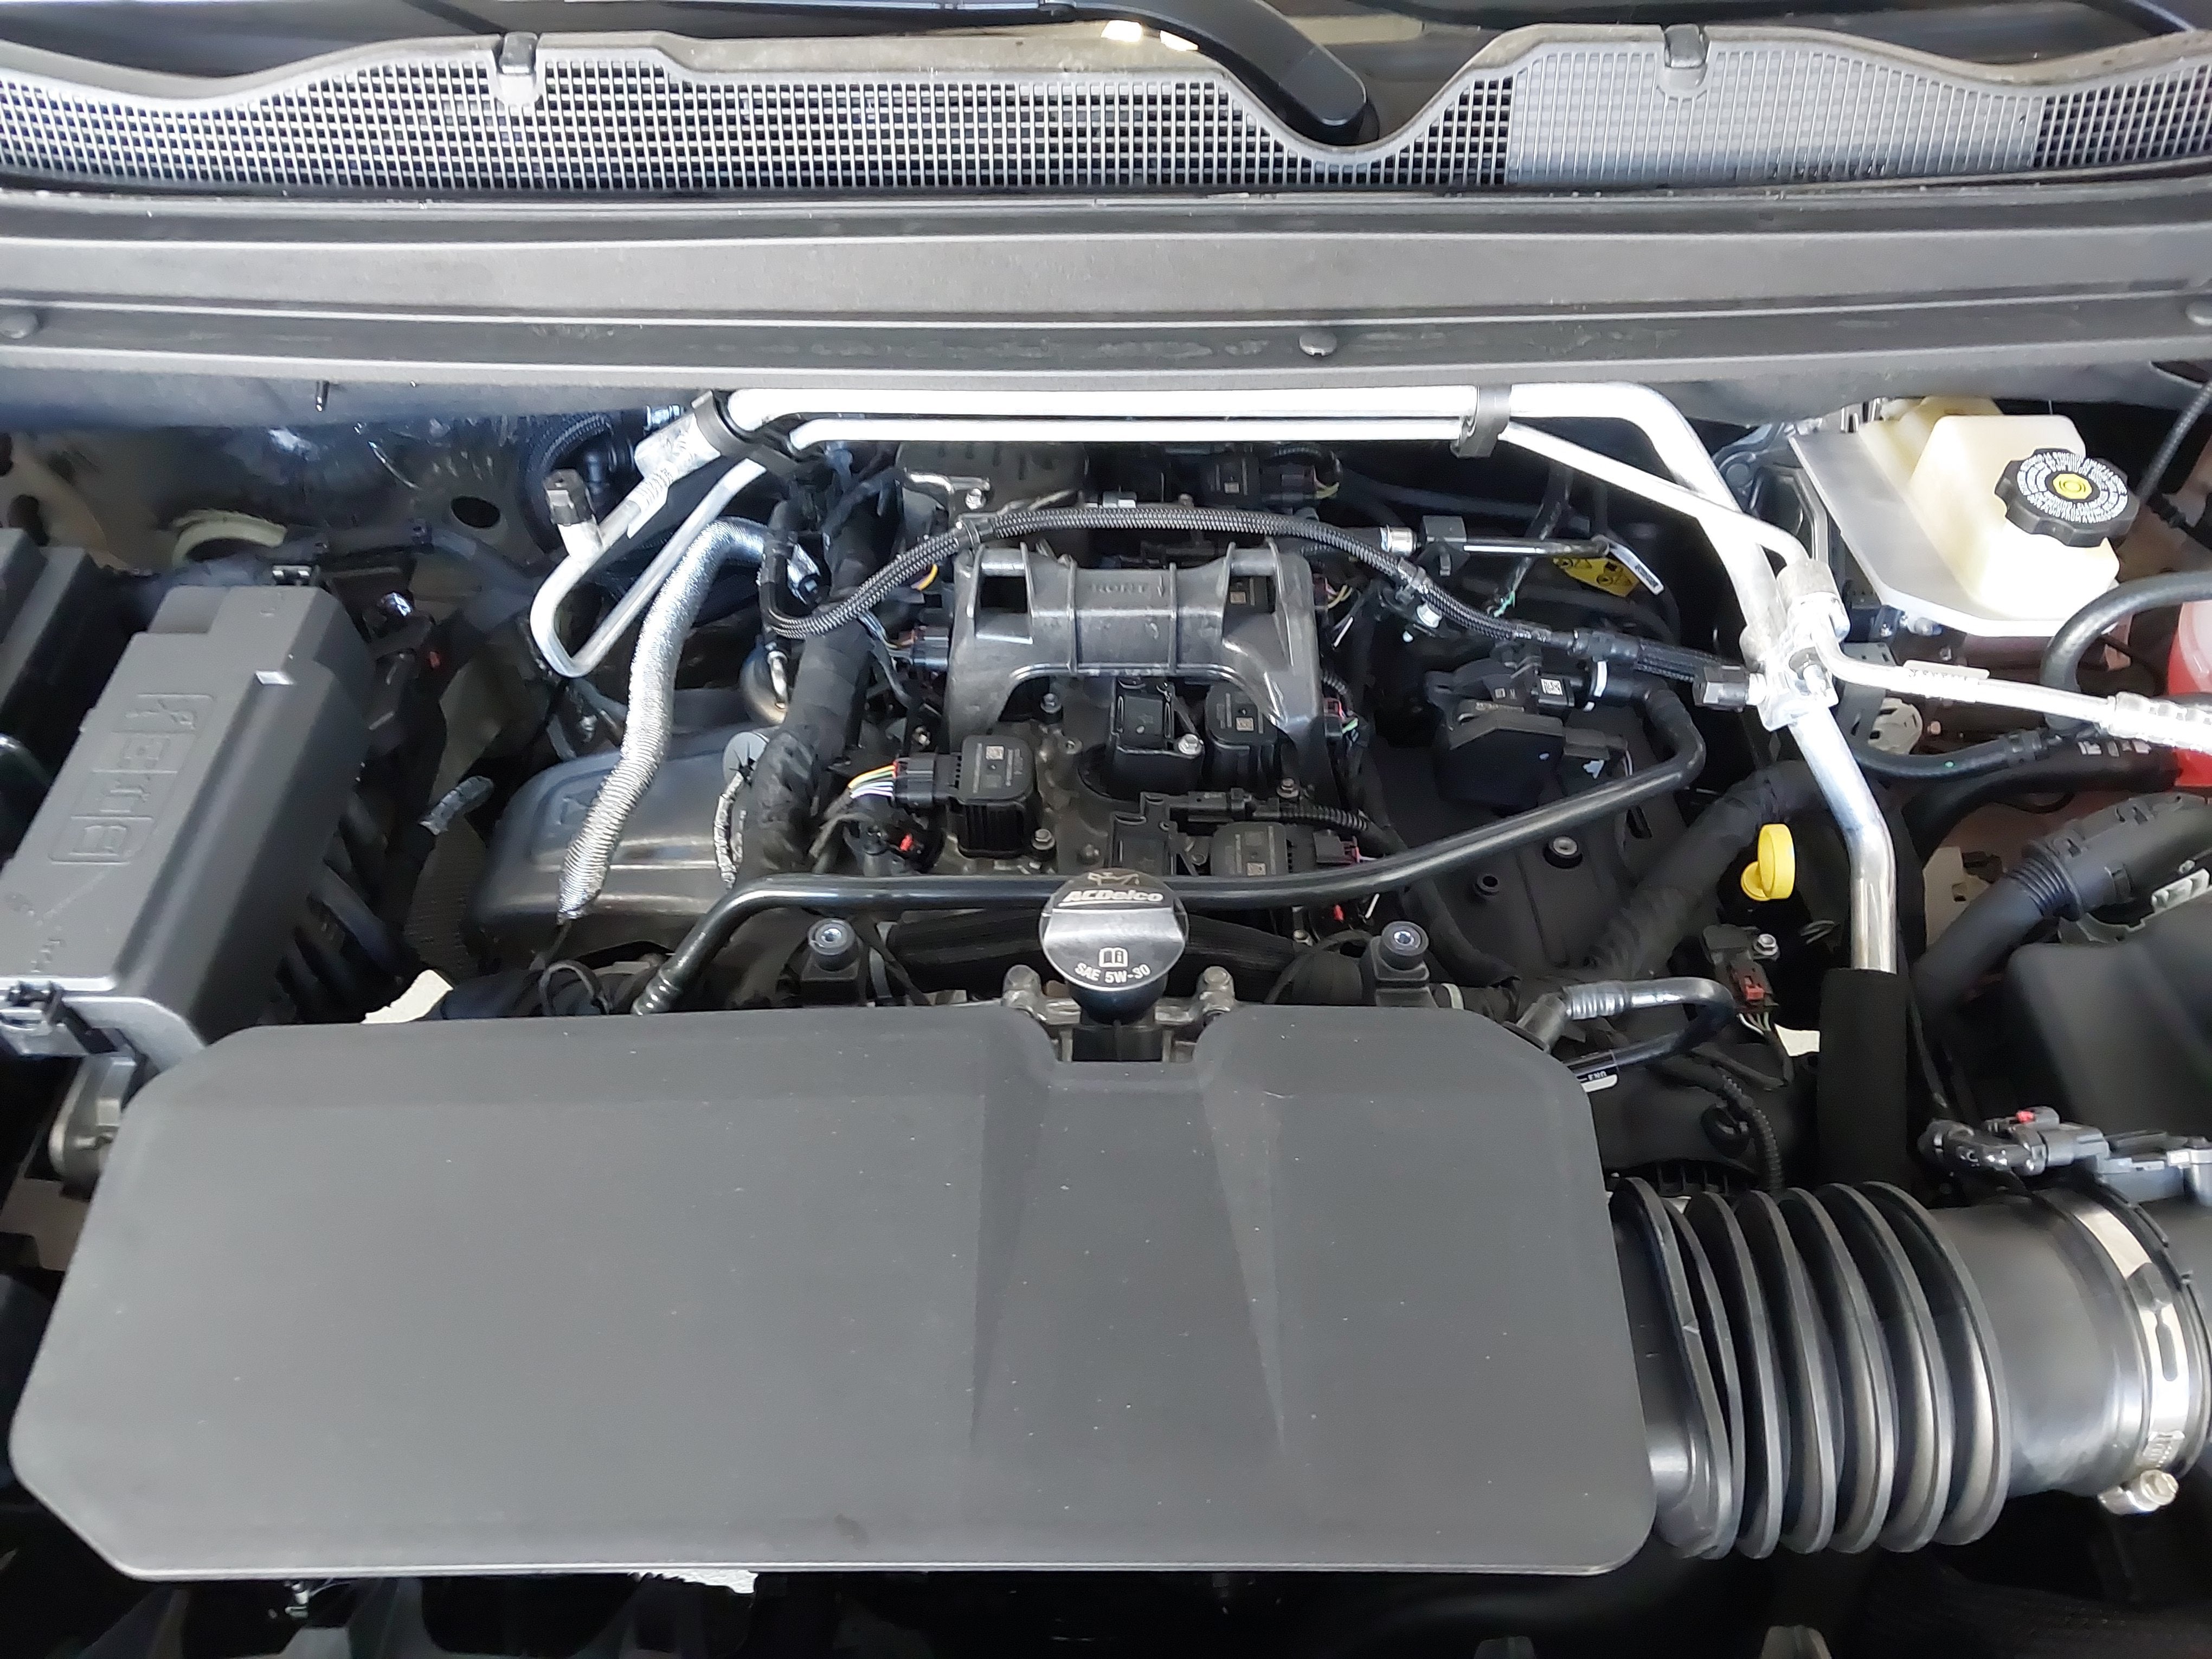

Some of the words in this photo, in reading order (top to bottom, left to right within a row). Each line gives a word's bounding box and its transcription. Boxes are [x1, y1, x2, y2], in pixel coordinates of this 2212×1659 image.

[1063, 889, 1163, 902] ACDelco
[1075, 962, 1101, 981] SAE
[1104, 963, 1151, 983] 5W-30
